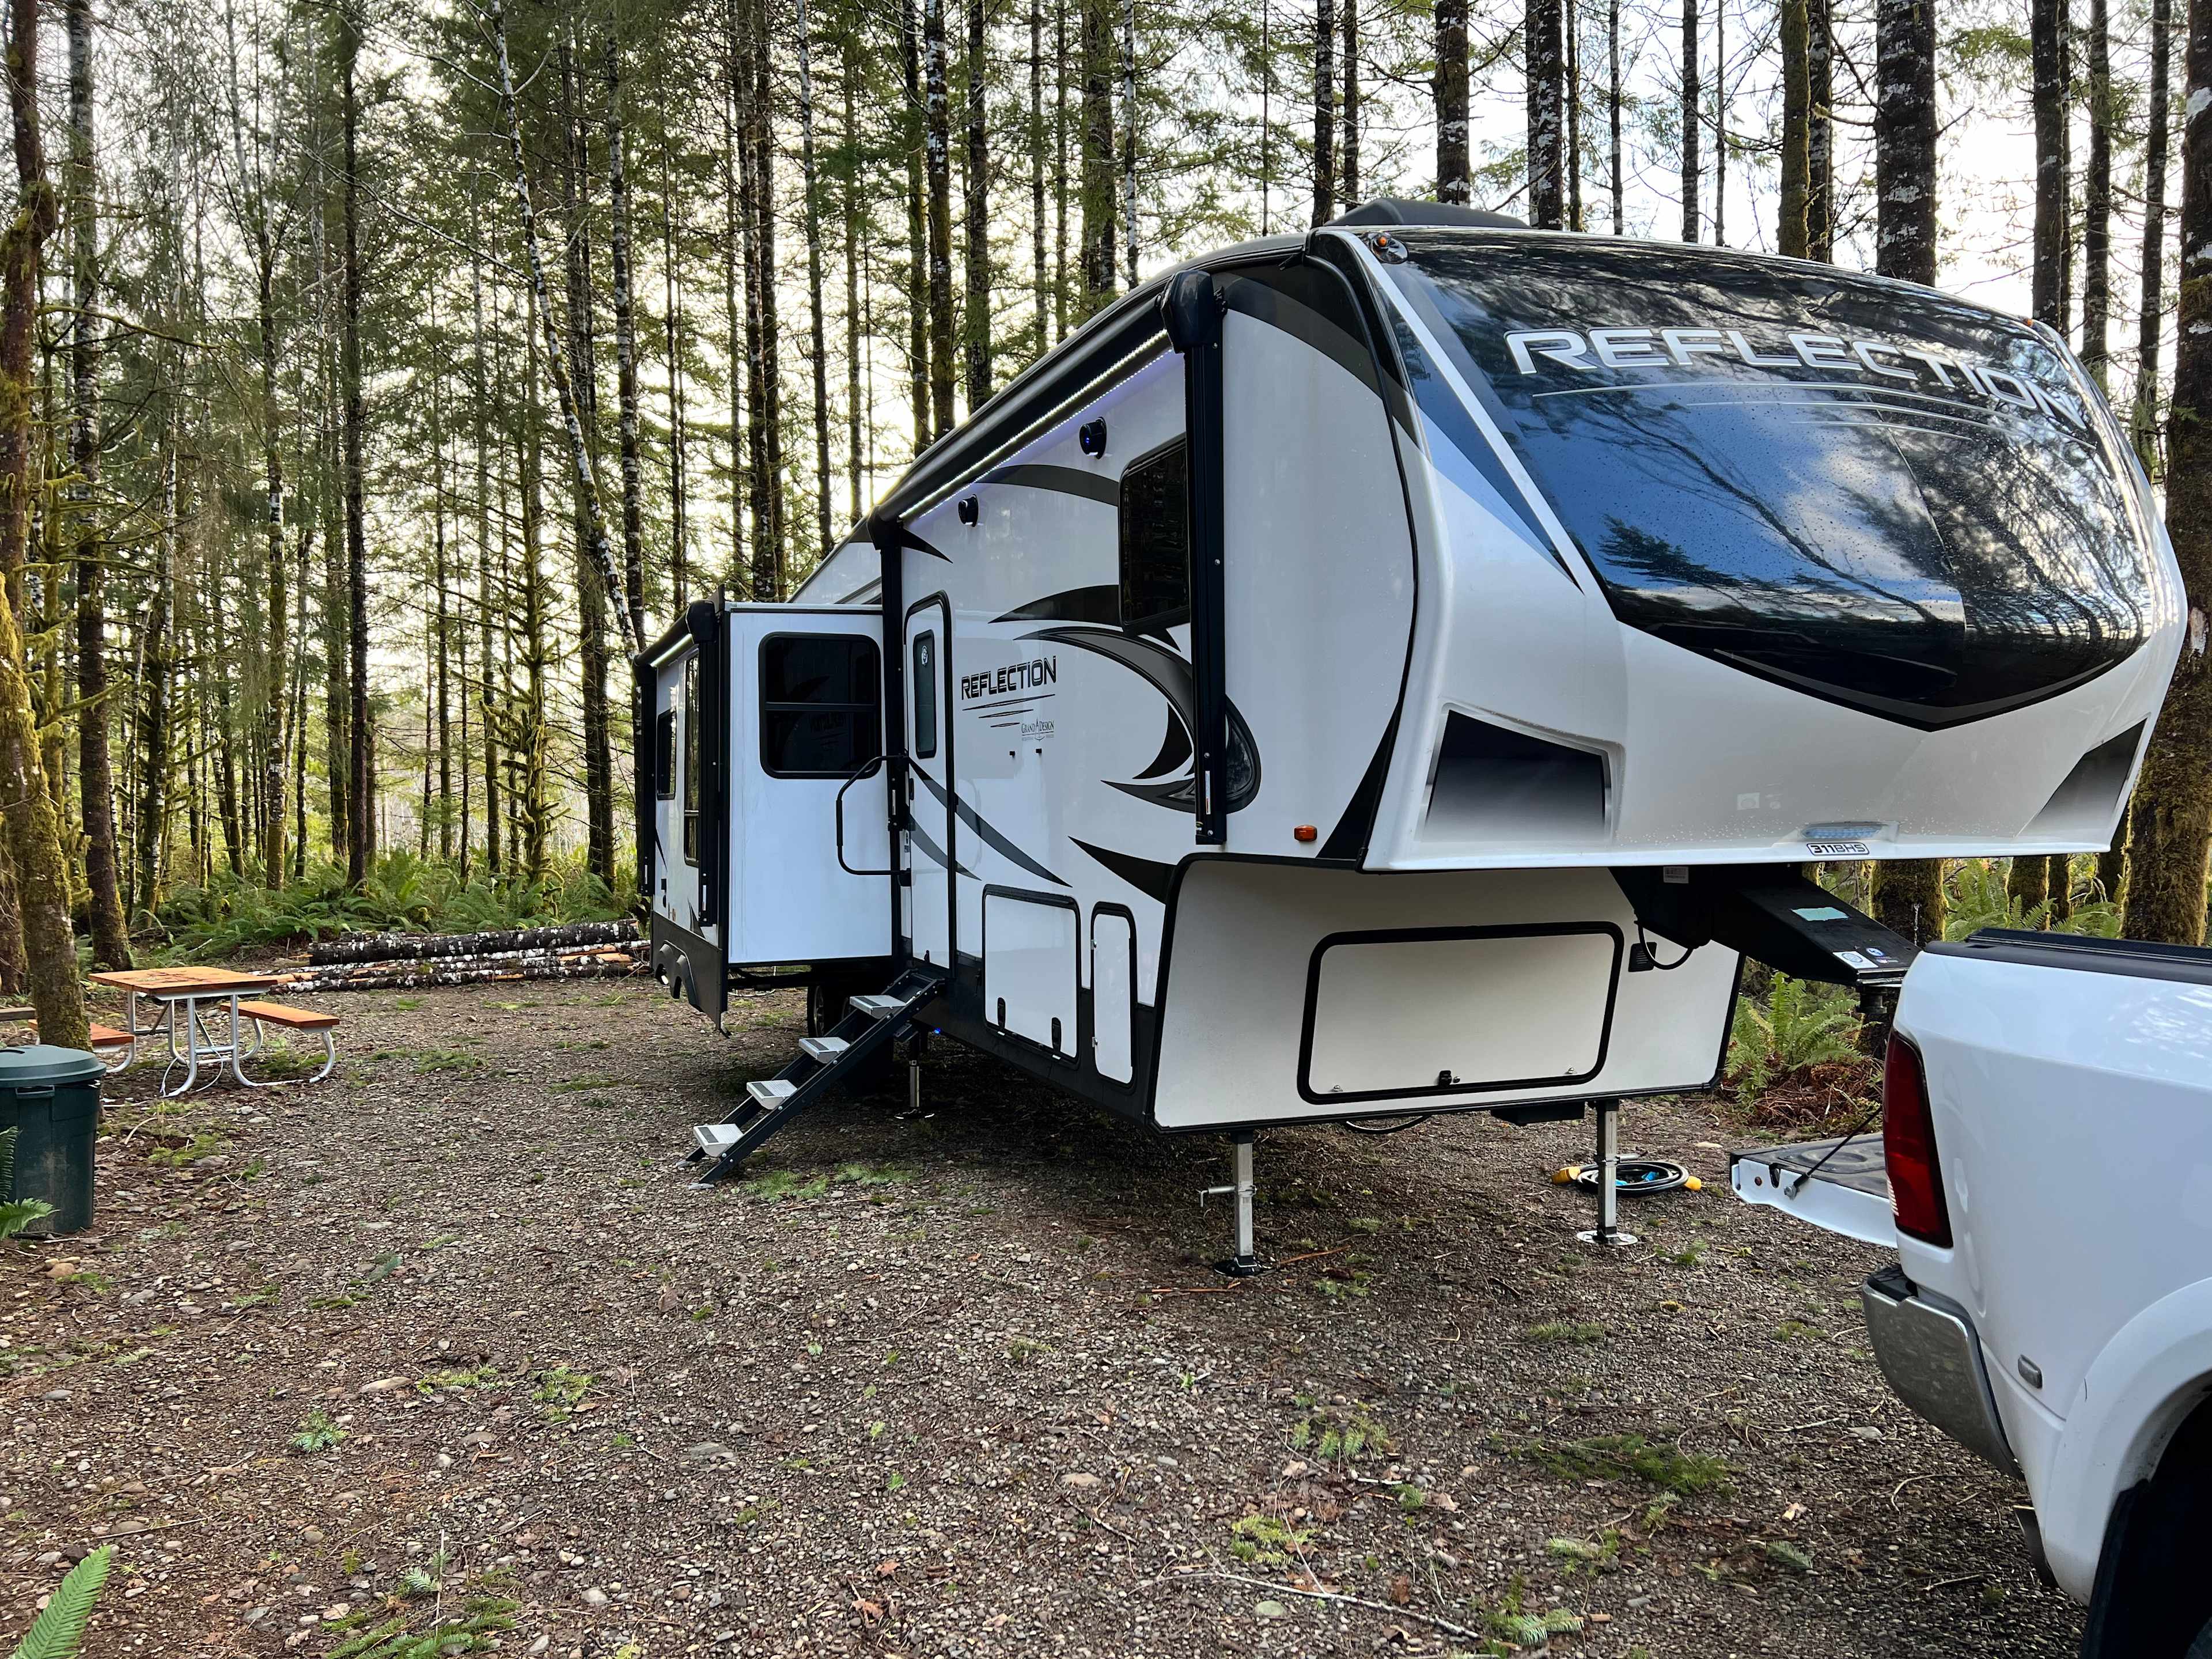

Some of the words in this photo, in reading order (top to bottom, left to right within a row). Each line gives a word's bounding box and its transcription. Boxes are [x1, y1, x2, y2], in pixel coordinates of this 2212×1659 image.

[1504, 326, 2088, 431] REFLECTION
[961, 655, 1056, 700] REFLECTION
[1810, 844, 1865, 853] 311BHS
